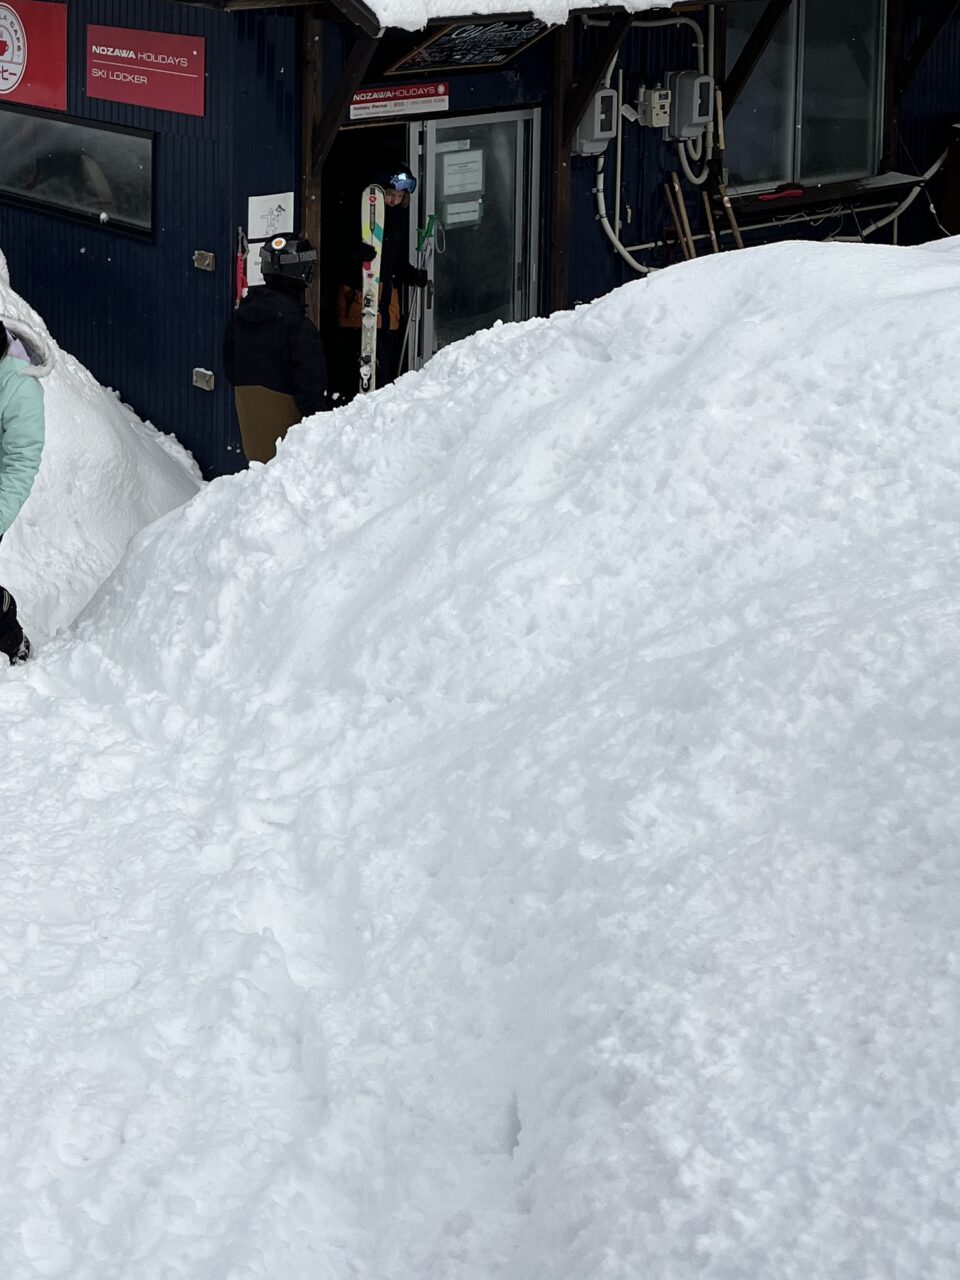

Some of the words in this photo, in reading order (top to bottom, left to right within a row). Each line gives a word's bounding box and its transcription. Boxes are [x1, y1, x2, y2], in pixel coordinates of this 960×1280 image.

[9, 21, 22, 52] CAFE
[92, 45, 136, 58] NOZAWA
[138, 51, 188, 67] HOLIDAYS
[92, 68, 107, 79] SKI
[109, 69, 148, 85] LOCKER
